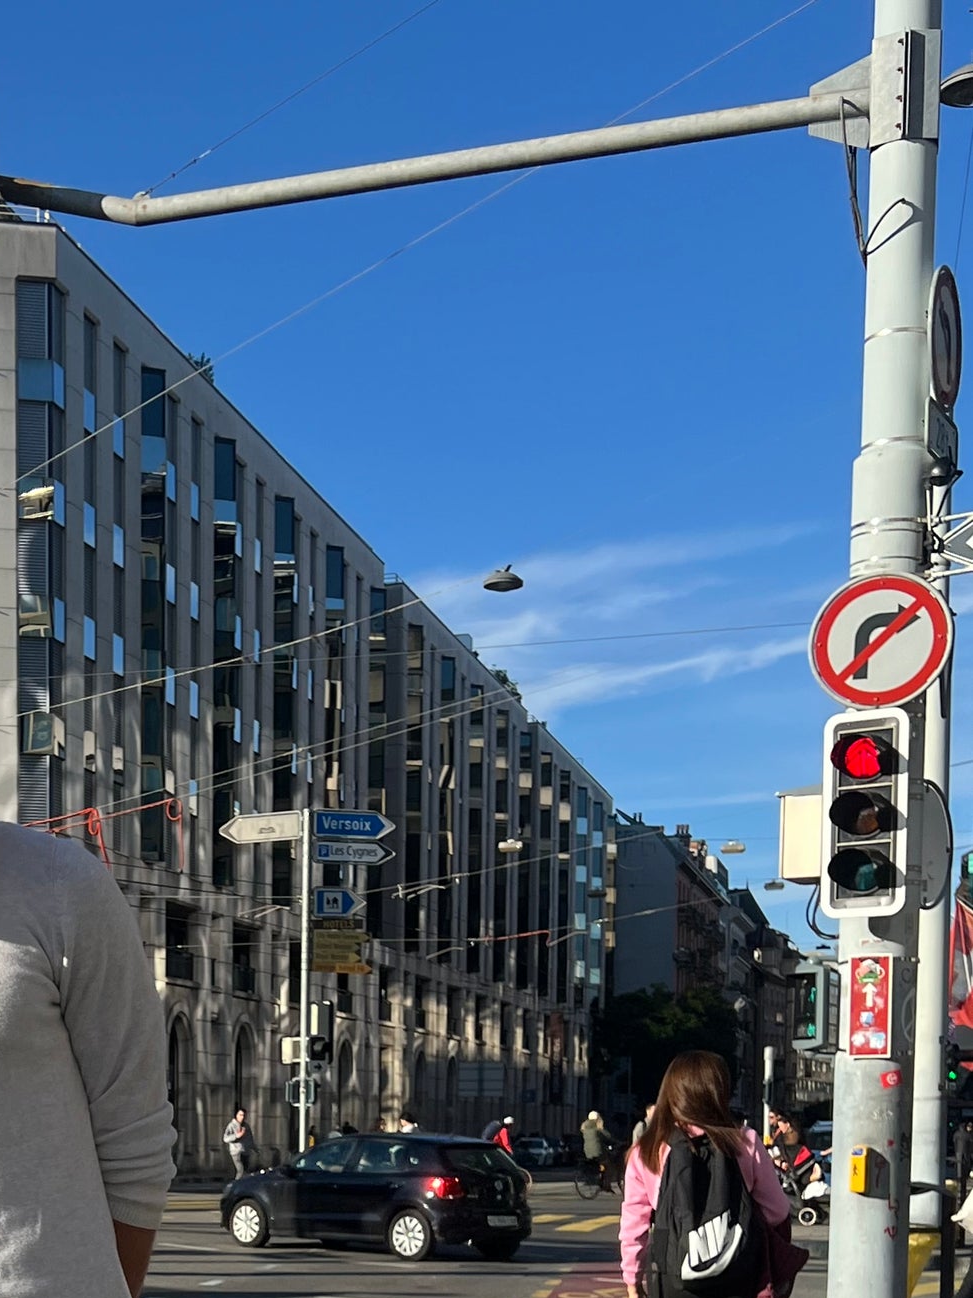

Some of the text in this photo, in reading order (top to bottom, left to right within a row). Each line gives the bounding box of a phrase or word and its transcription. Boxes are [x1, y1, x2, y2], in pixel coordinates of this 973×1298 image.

[322, 816, 371, 831] Versoix
[330, 845, 345, 856] Les
[346, 845, 378, 860] Cygnes
[323, 920, 355, 929] HOTELS
